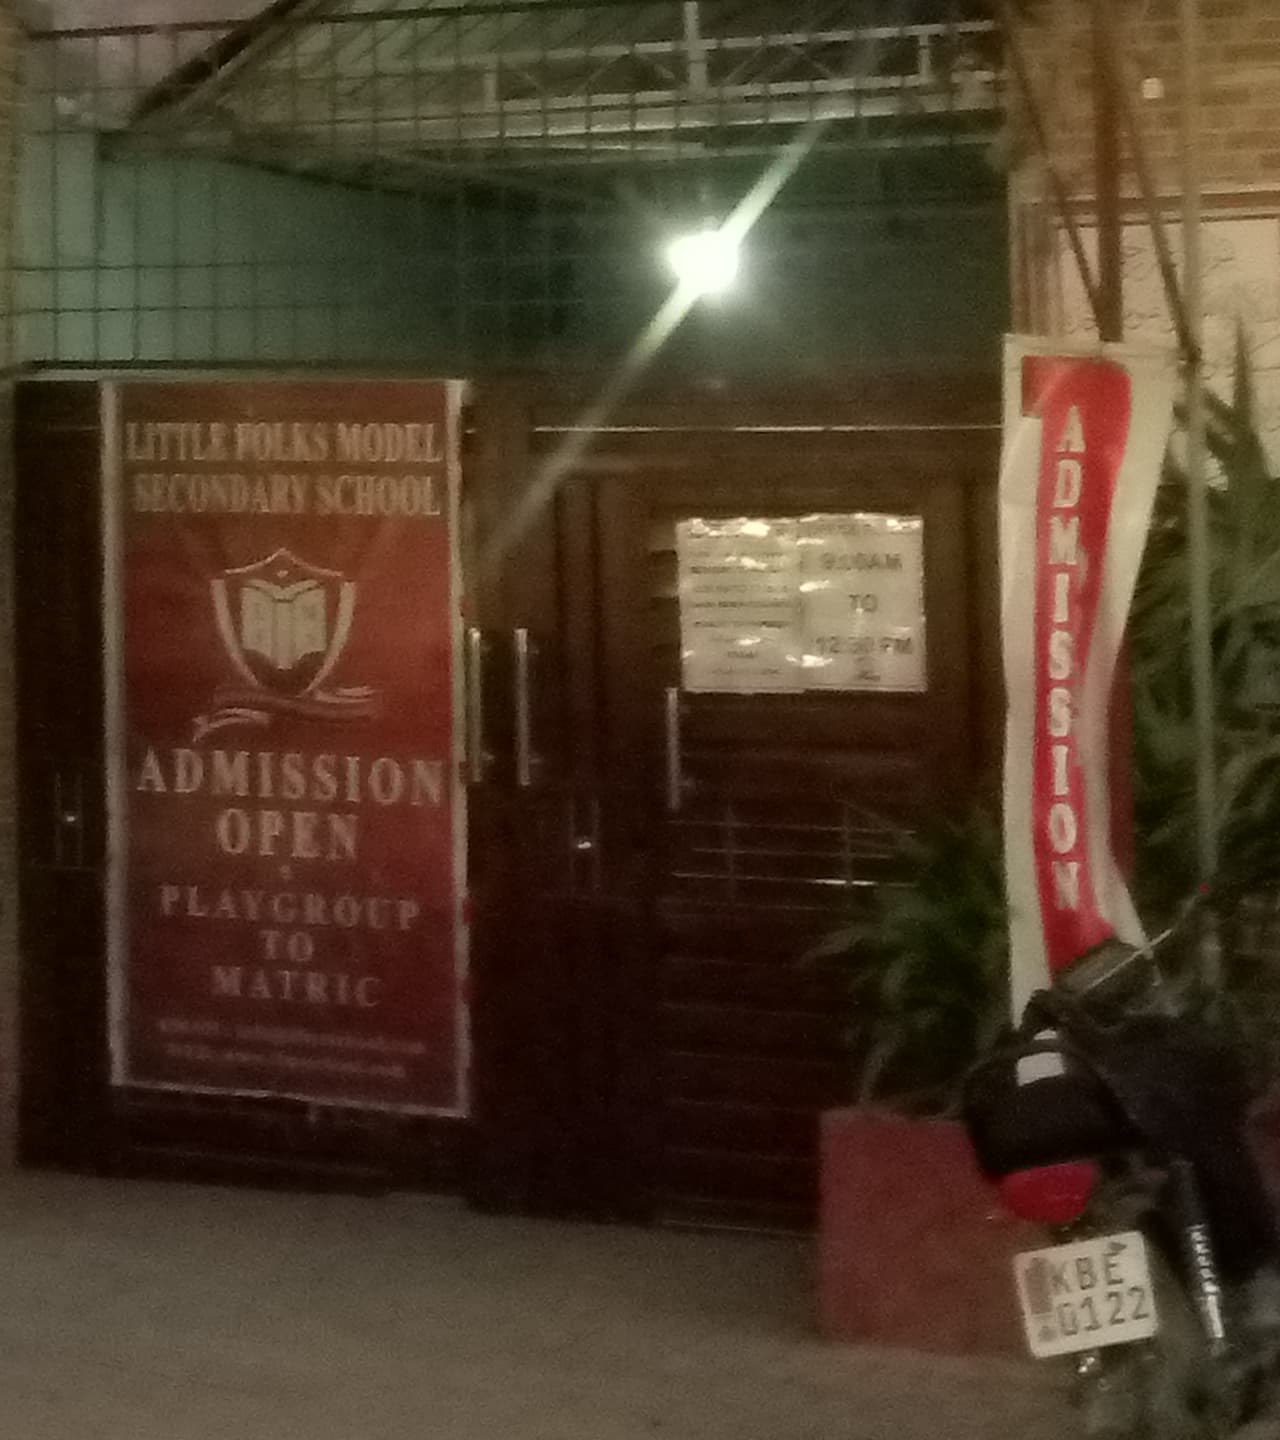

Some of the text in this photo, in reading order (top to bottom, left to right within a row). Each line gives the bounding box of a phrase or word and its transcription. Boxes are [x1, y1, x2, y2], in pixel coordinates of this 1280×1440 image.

[125, 421, 441, 463] LITTLE FOLKS MODEL
[136, 473, 441, 516] SECONDARY SCHOOL
[1047, 404, 1086, 910] ADMISSION
[136, 744, 443, 807] ADMISSION
[215, 807, 360, 861] OPEN
[158, 884, 422, 931] PLAYGROUP
[259, 928, 316, 963] TO
[209, 964, 386, 1008] MATRIC
